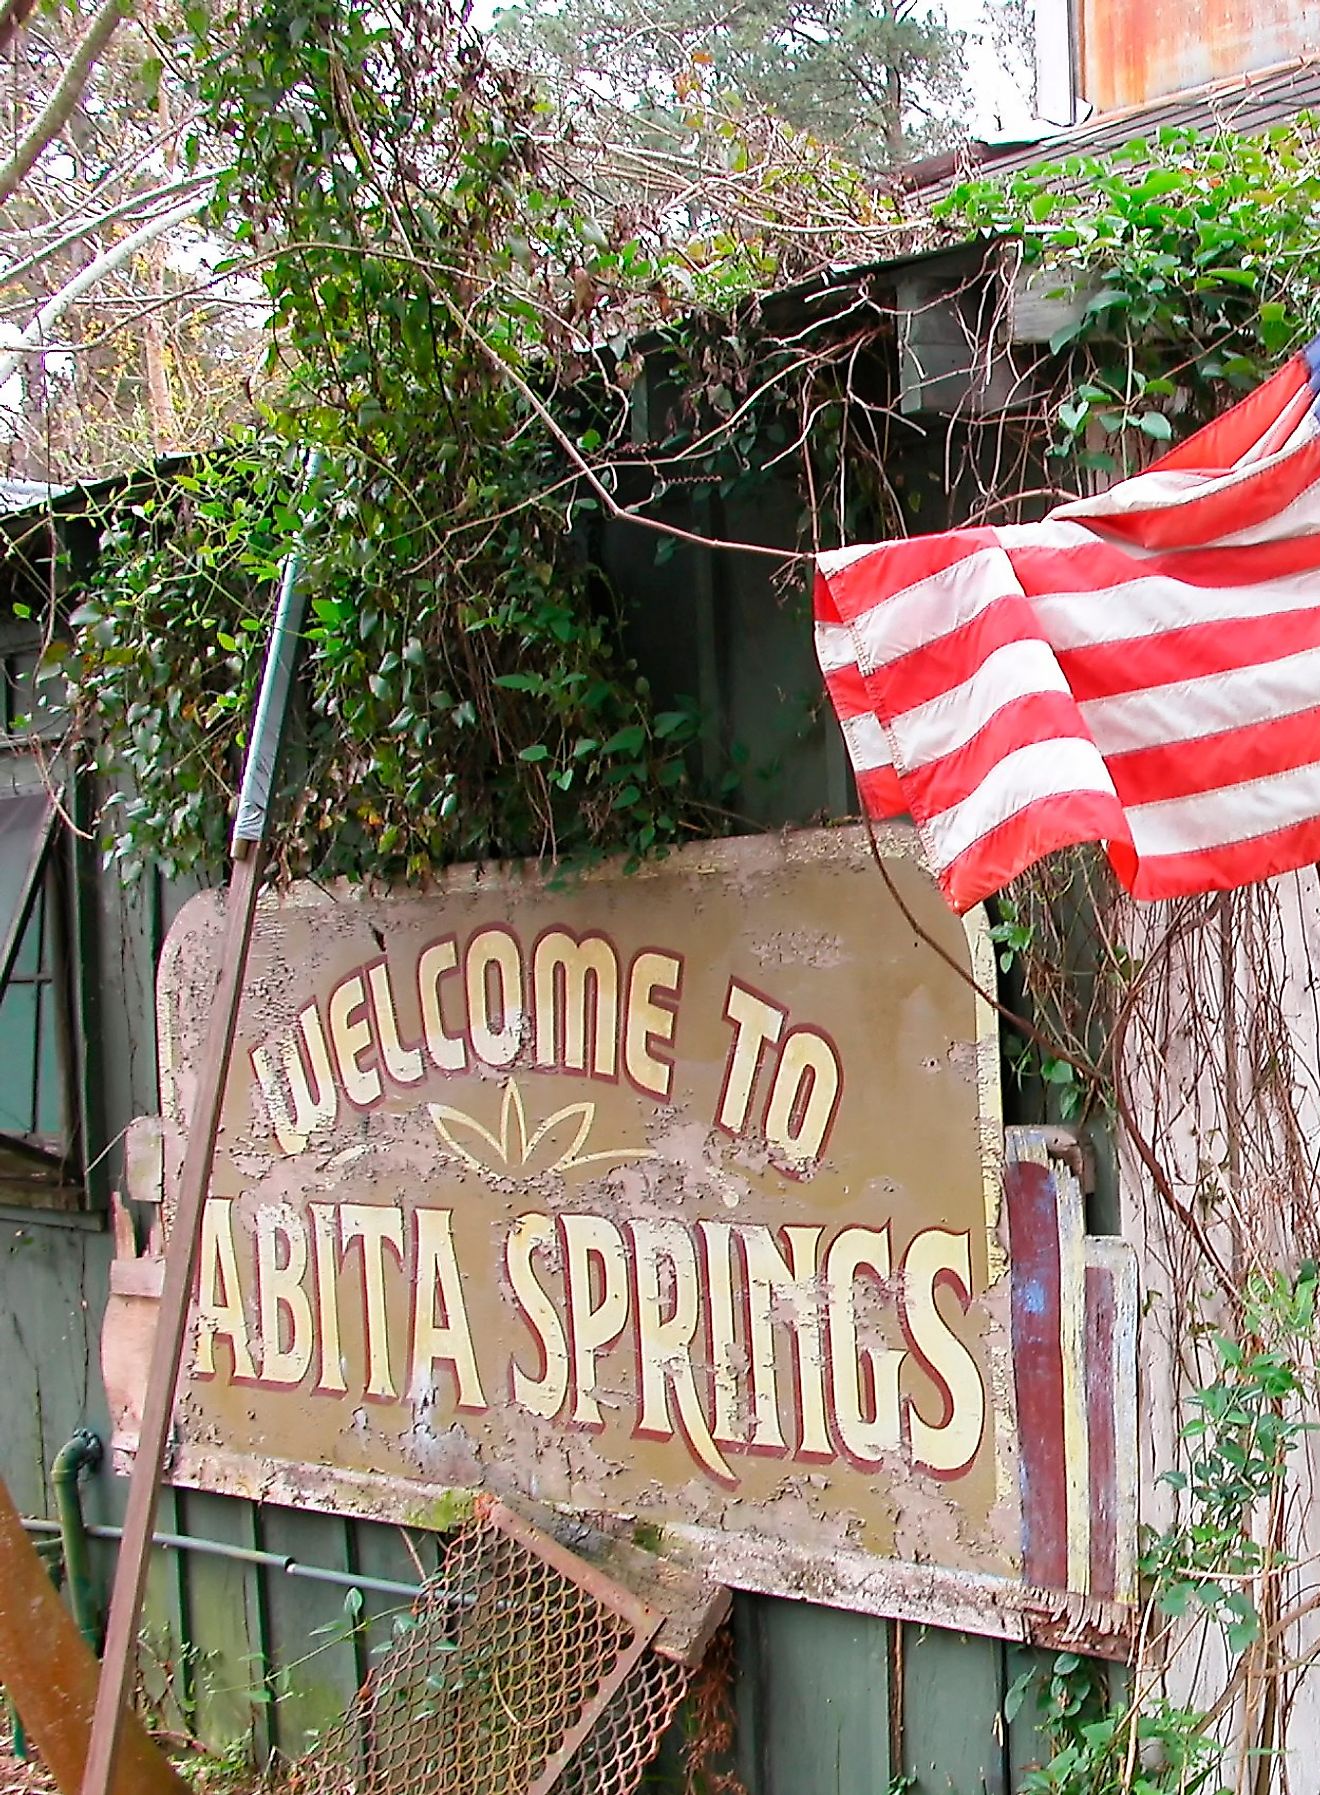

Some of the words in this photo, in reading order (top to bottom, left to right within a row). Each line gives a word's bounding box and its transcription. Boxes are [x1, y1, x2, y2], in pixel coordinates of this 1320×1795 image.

[248, 920, 685, 1157] WELCOME
[715, 974, 845, 1182] TO
[194, 1197, 489, 1413] ABITA
[502, 1210, 987, 1490] SPRINGS
